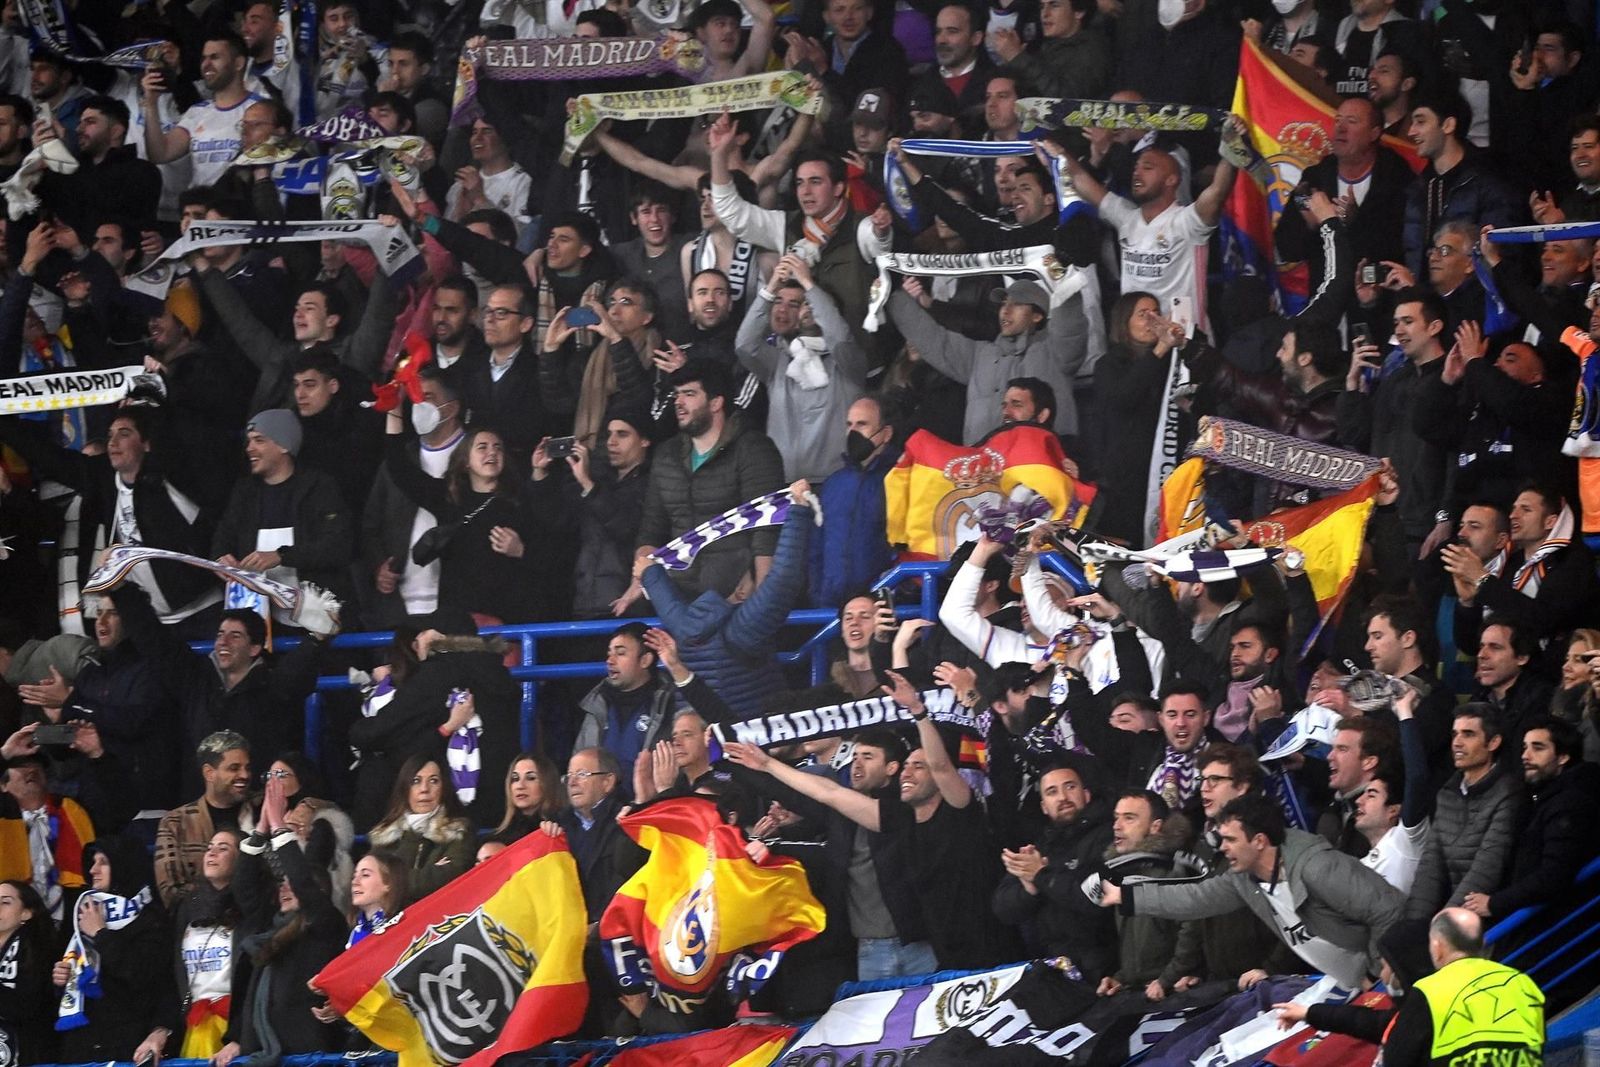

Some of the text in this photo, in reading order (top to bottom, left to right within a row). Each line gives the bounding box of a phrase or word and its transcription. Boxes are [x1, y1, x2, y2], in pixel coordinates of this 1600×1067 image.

[543, 39, 656, 68] MADRID
[1336, 77, 1368, 93] mira
[728, 242, 752, 301] DRID
[0, 371, 125, 399] EAL MADRID
[1230, 429, 1365, 482] REAL MADRID
